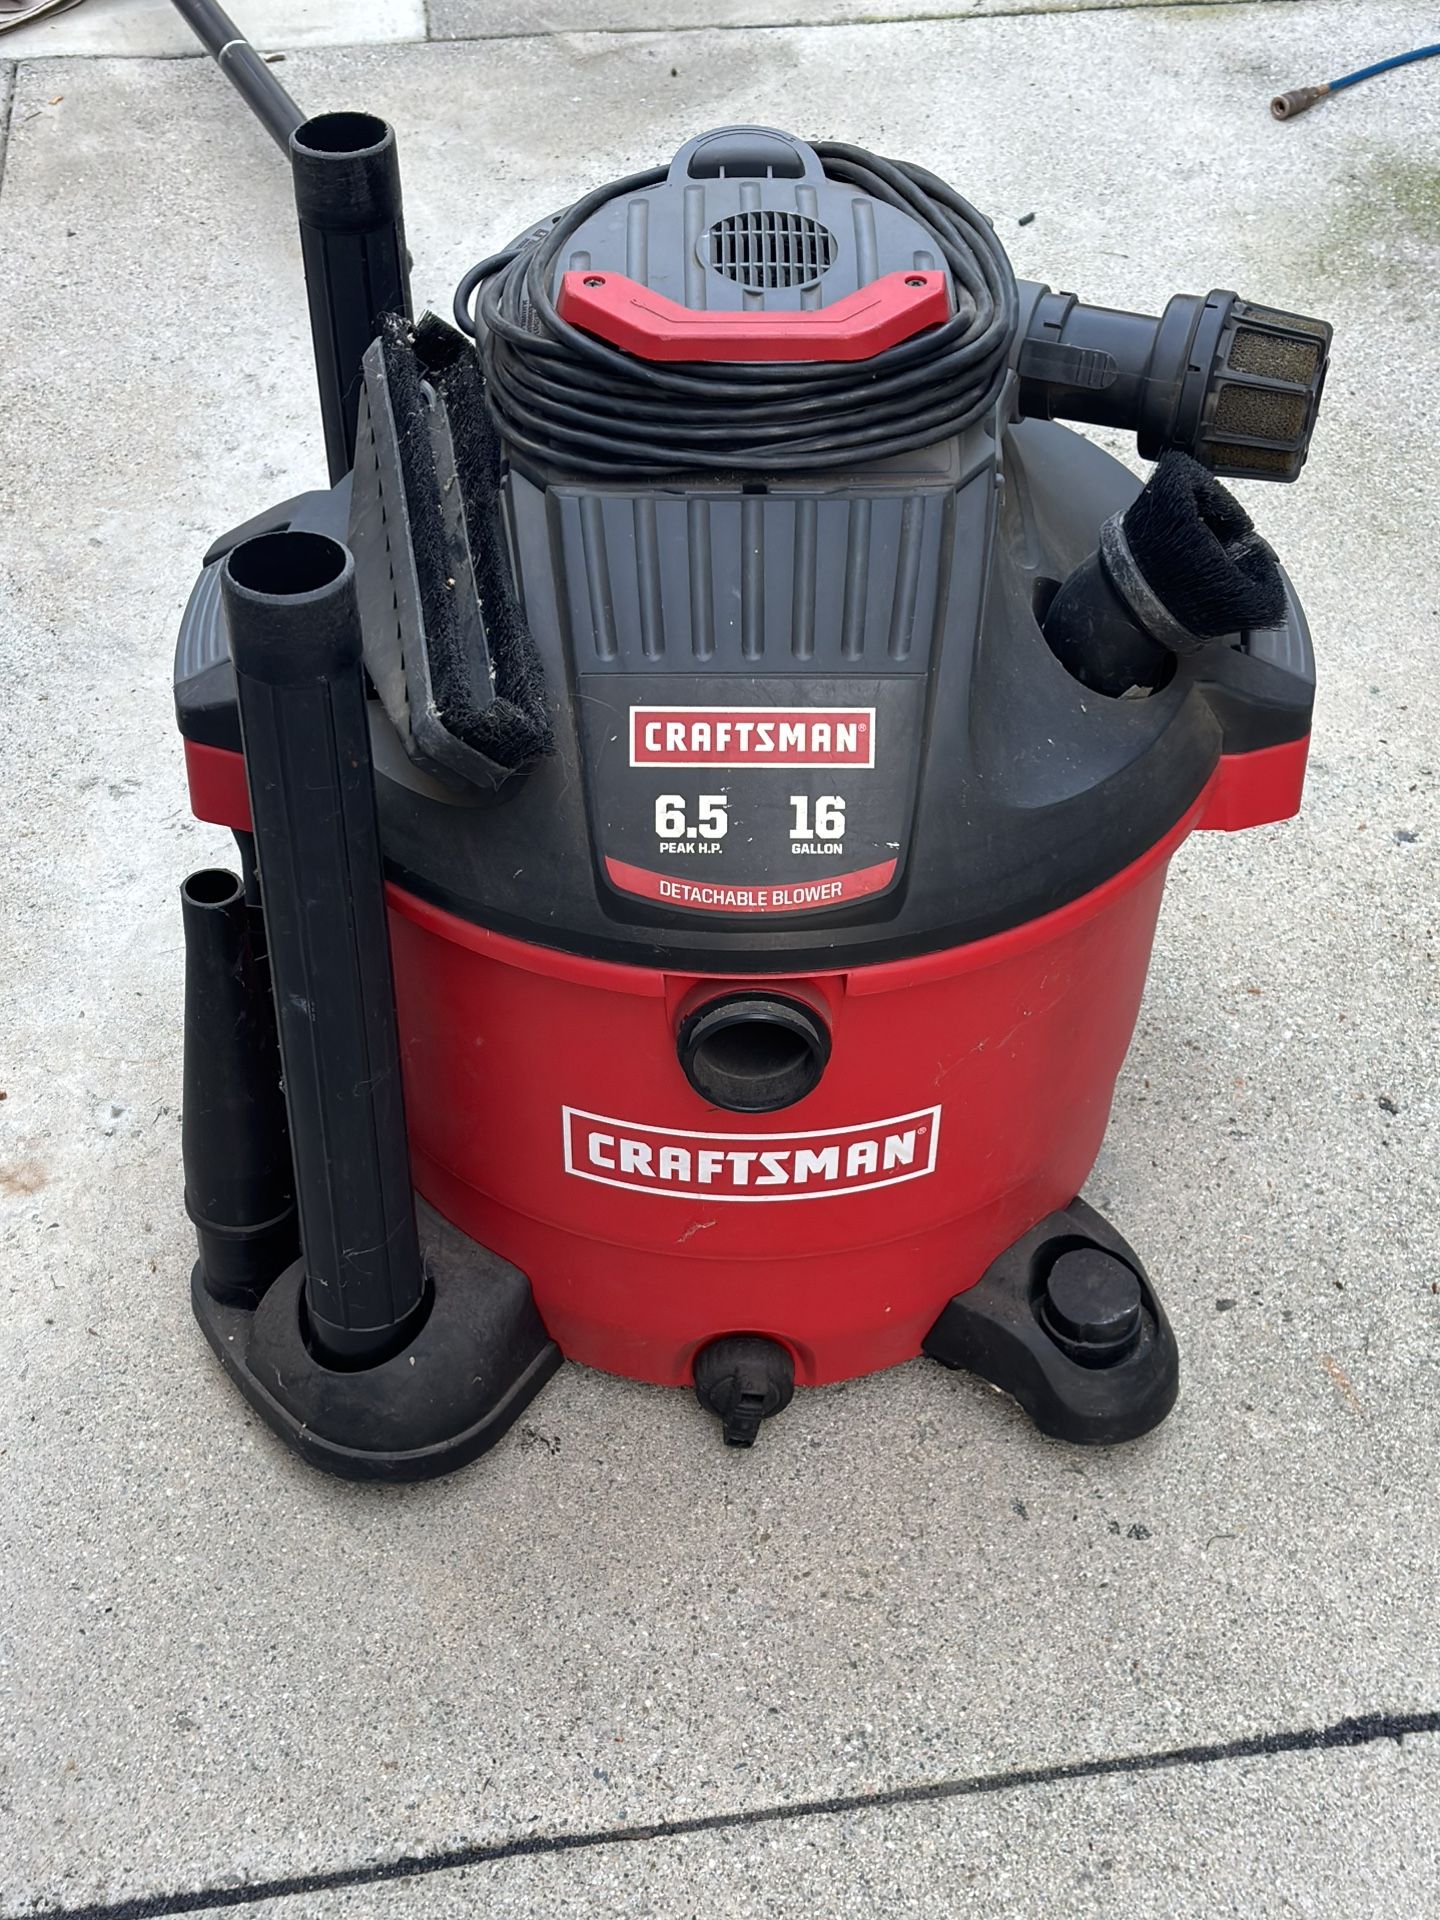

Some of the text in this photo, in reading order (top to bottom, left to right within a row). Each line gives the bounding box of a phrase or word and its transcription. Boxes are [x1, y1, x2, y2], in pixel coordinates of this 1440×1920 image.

[655, 794, 728, 839] 6.5
[789, 795, 846, 839] 16
[660, 842, 723, 854] PEAK H.P.
[791, 843, 843, 854] GALLON
[659, 880, 842, 906] DETACHABLE BLOWER
